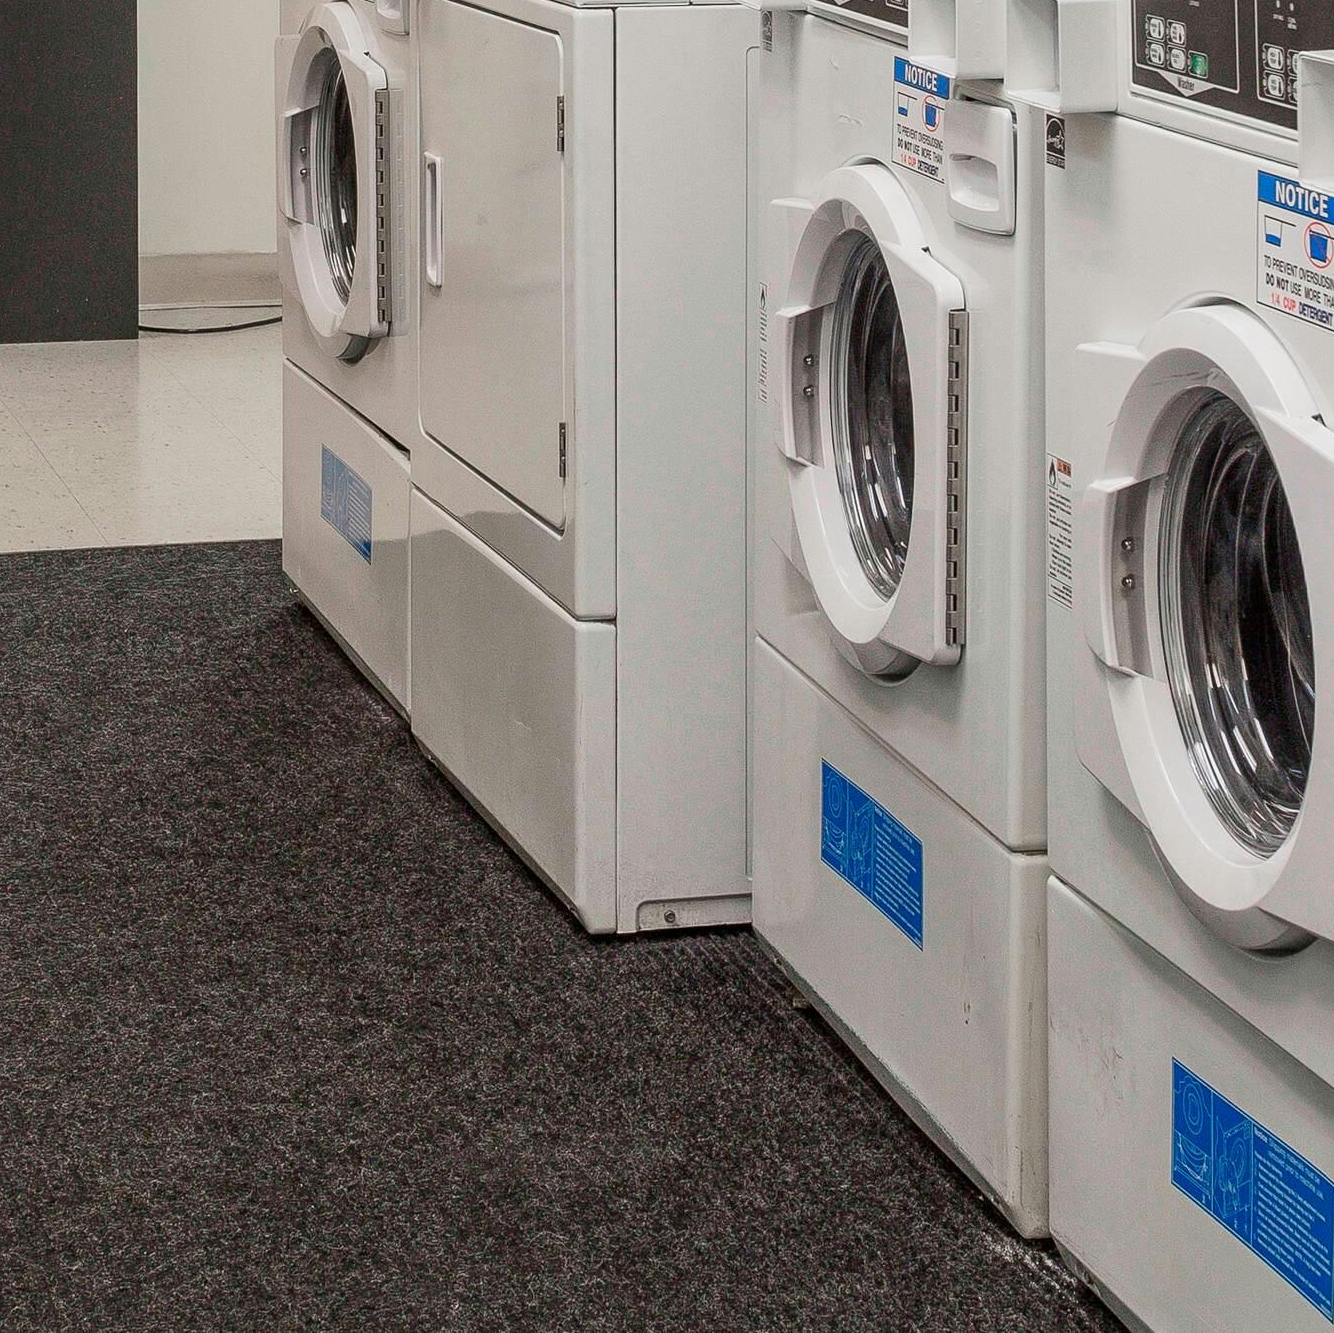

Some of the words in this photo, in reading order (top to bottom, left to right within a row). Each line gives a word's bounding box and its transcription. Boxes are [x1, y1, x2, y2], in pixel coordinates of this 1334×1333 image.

[905, 64, 938, 92] NOTICE
[1177, 76, 1195, 91] Washer
[902, 125, 918, 139] PREVENT
[897, 138, 903, 148] DO
[904, 140, 912, 151] NOT
[921, 146, 932, 160] MORE
[932, 152, 943, 164] THAN
[1275, 180, 1329, 218] NOTICE
[1264, 255, 1272, 265] TO
[1272, 258, 1298, 277] PREVENT
[1266, 273, 1274, 286] DO
[1276, 277, 1289, 291] NOT
[1290, 281, 1302, 297] USE
[1304, 286, 1321, 304] MORE
[1283, 296, 1296, 311] CUP
[1298, 301, 1334, 326] DETERGENT
